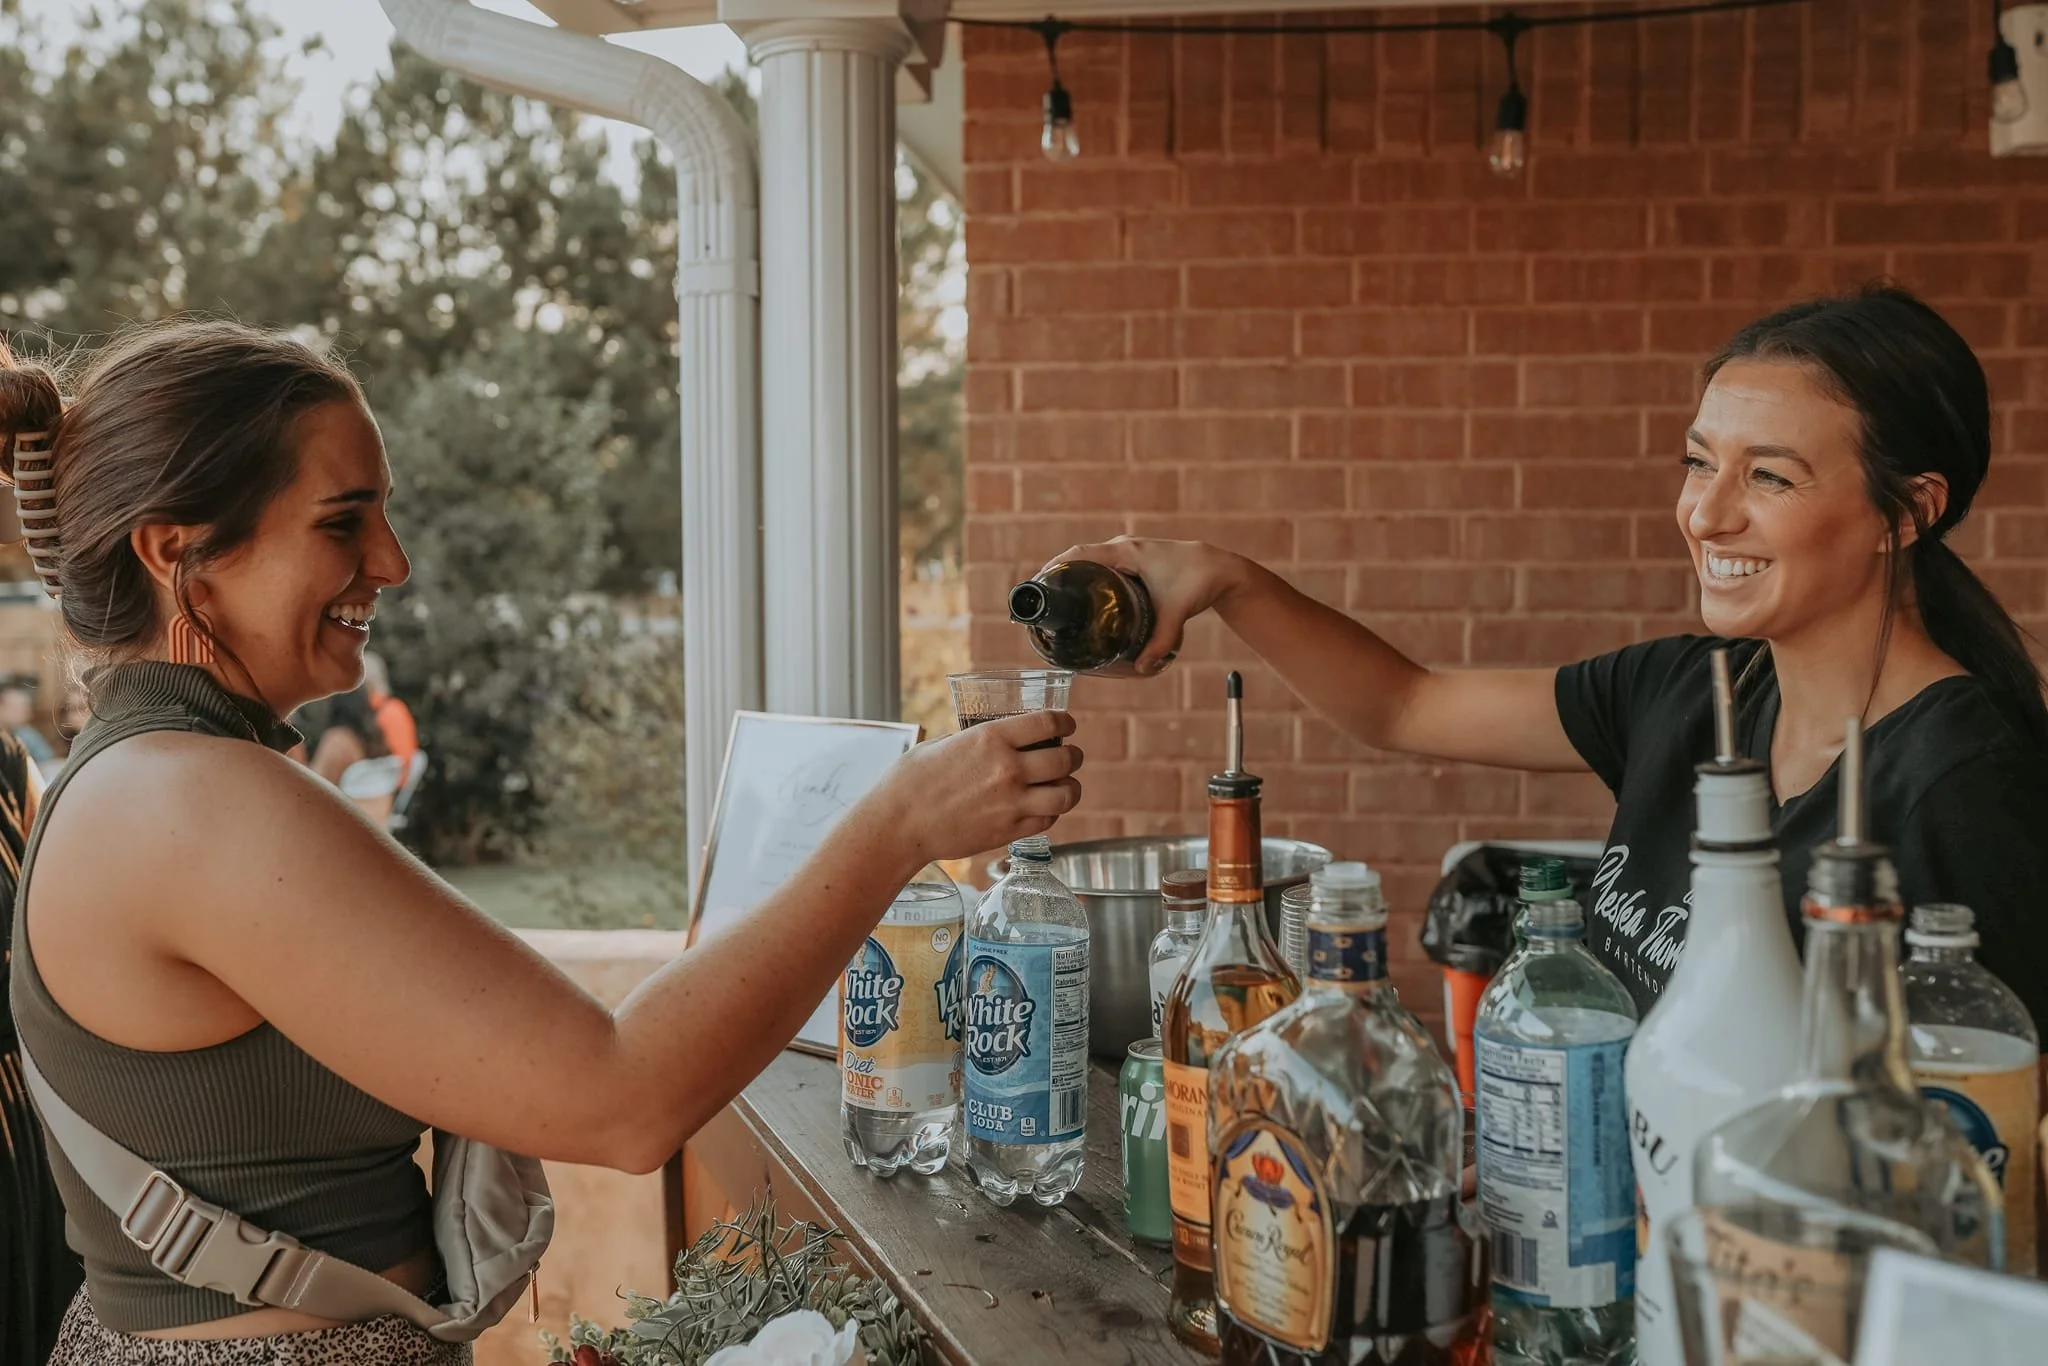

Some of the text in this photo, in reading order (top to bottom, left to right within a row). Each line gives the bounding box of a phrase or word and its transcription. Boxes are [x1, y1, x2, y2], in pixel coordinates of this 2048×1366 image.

[935, 933, 948, 942] NO
[845, 999, 897, 1030] Rock
[968, 1024, 1028, 1058] Rock
[846, 1051, 875, 1073] Diet
[845, 1070, 884, 1090] ONIC
[969, 1099, 1013, 1121] CLUB
[972, 1115, 1005, 1132] SODA
